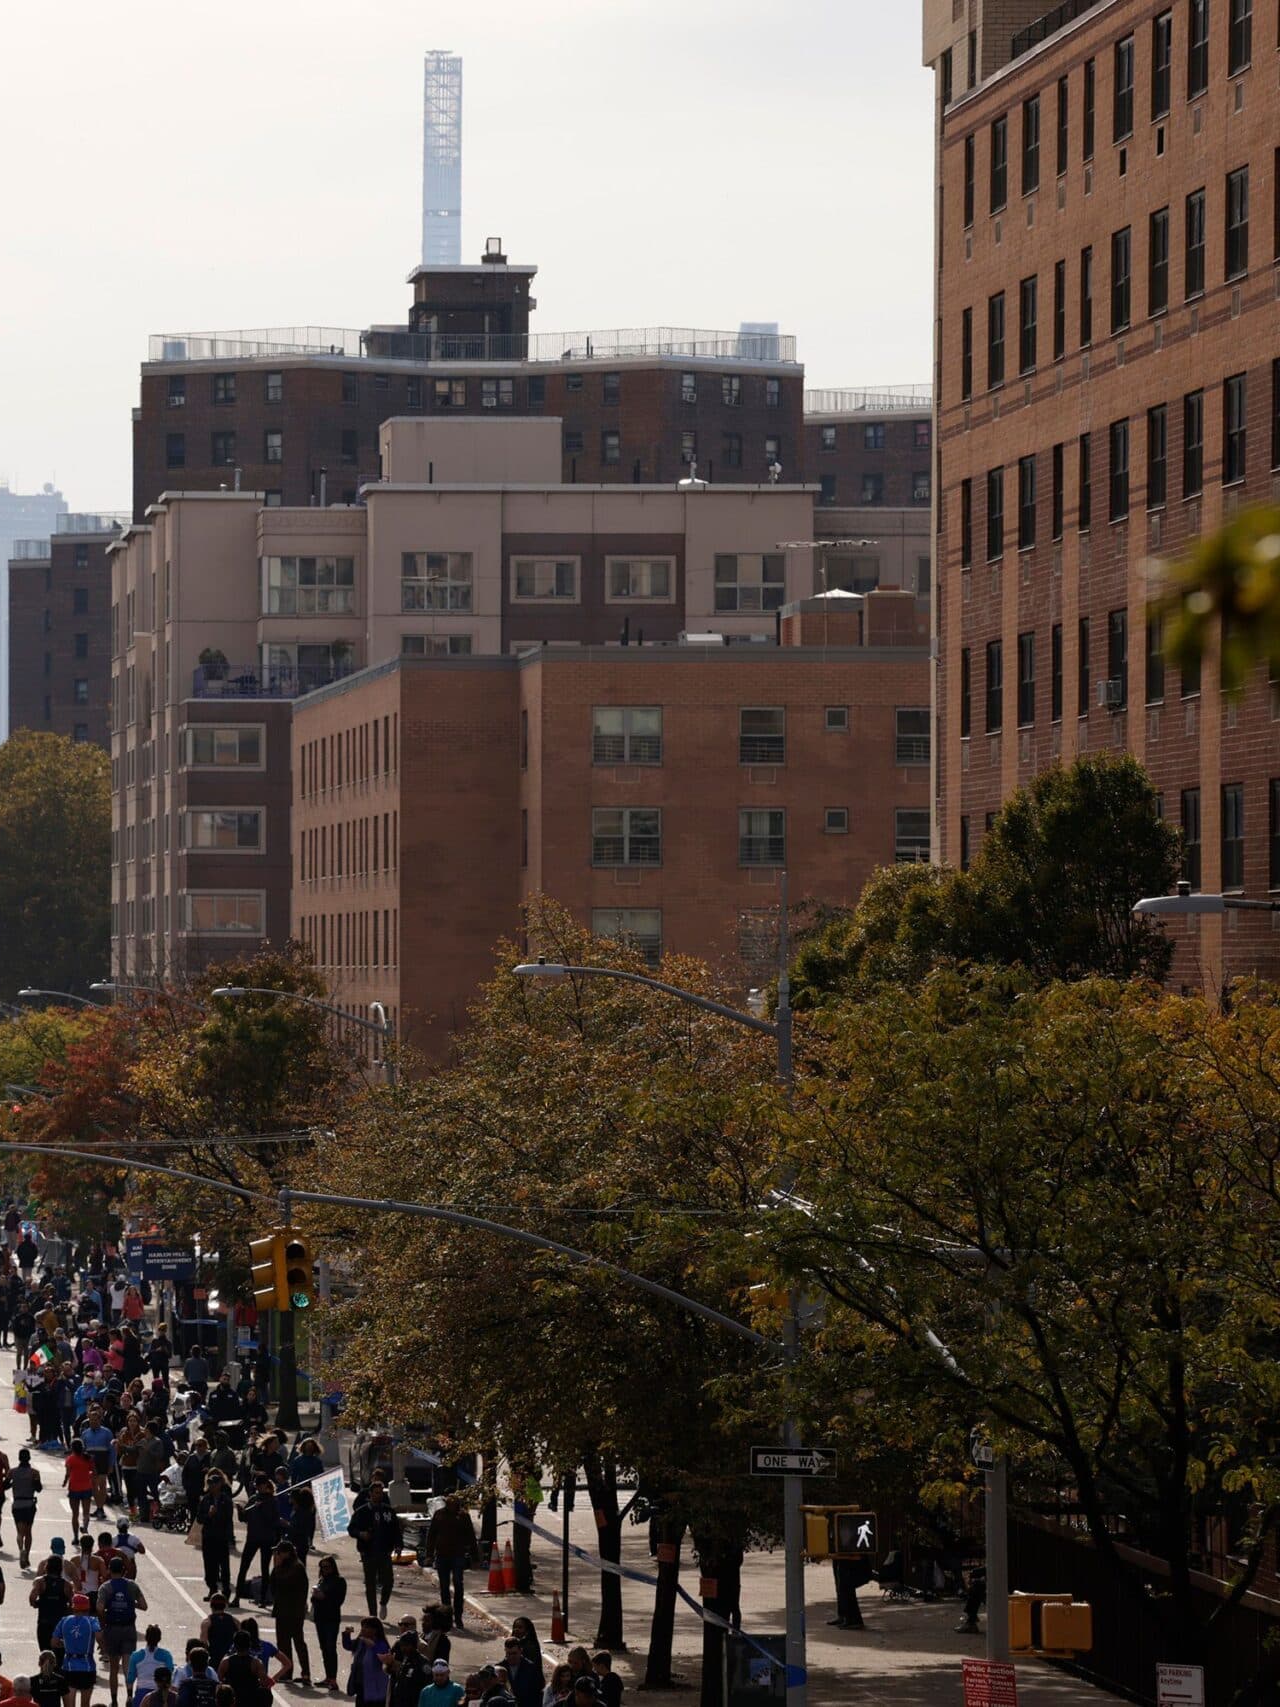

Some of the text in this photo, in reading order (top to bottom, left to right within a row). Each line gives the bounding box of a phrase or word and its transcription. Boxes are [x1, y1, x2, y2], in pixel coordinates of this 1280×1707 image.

[763, 1455, 823, 1468] ONE WAY
[325, 1507, 337, 1536] YORK
[963, 1664, 986, 1673] Public
[986, 1666, 1015, 1676] Auction
[1168, 1669, 1193, 1677] PARKING
[1160, 1677, 1182, 1686] Anytime
